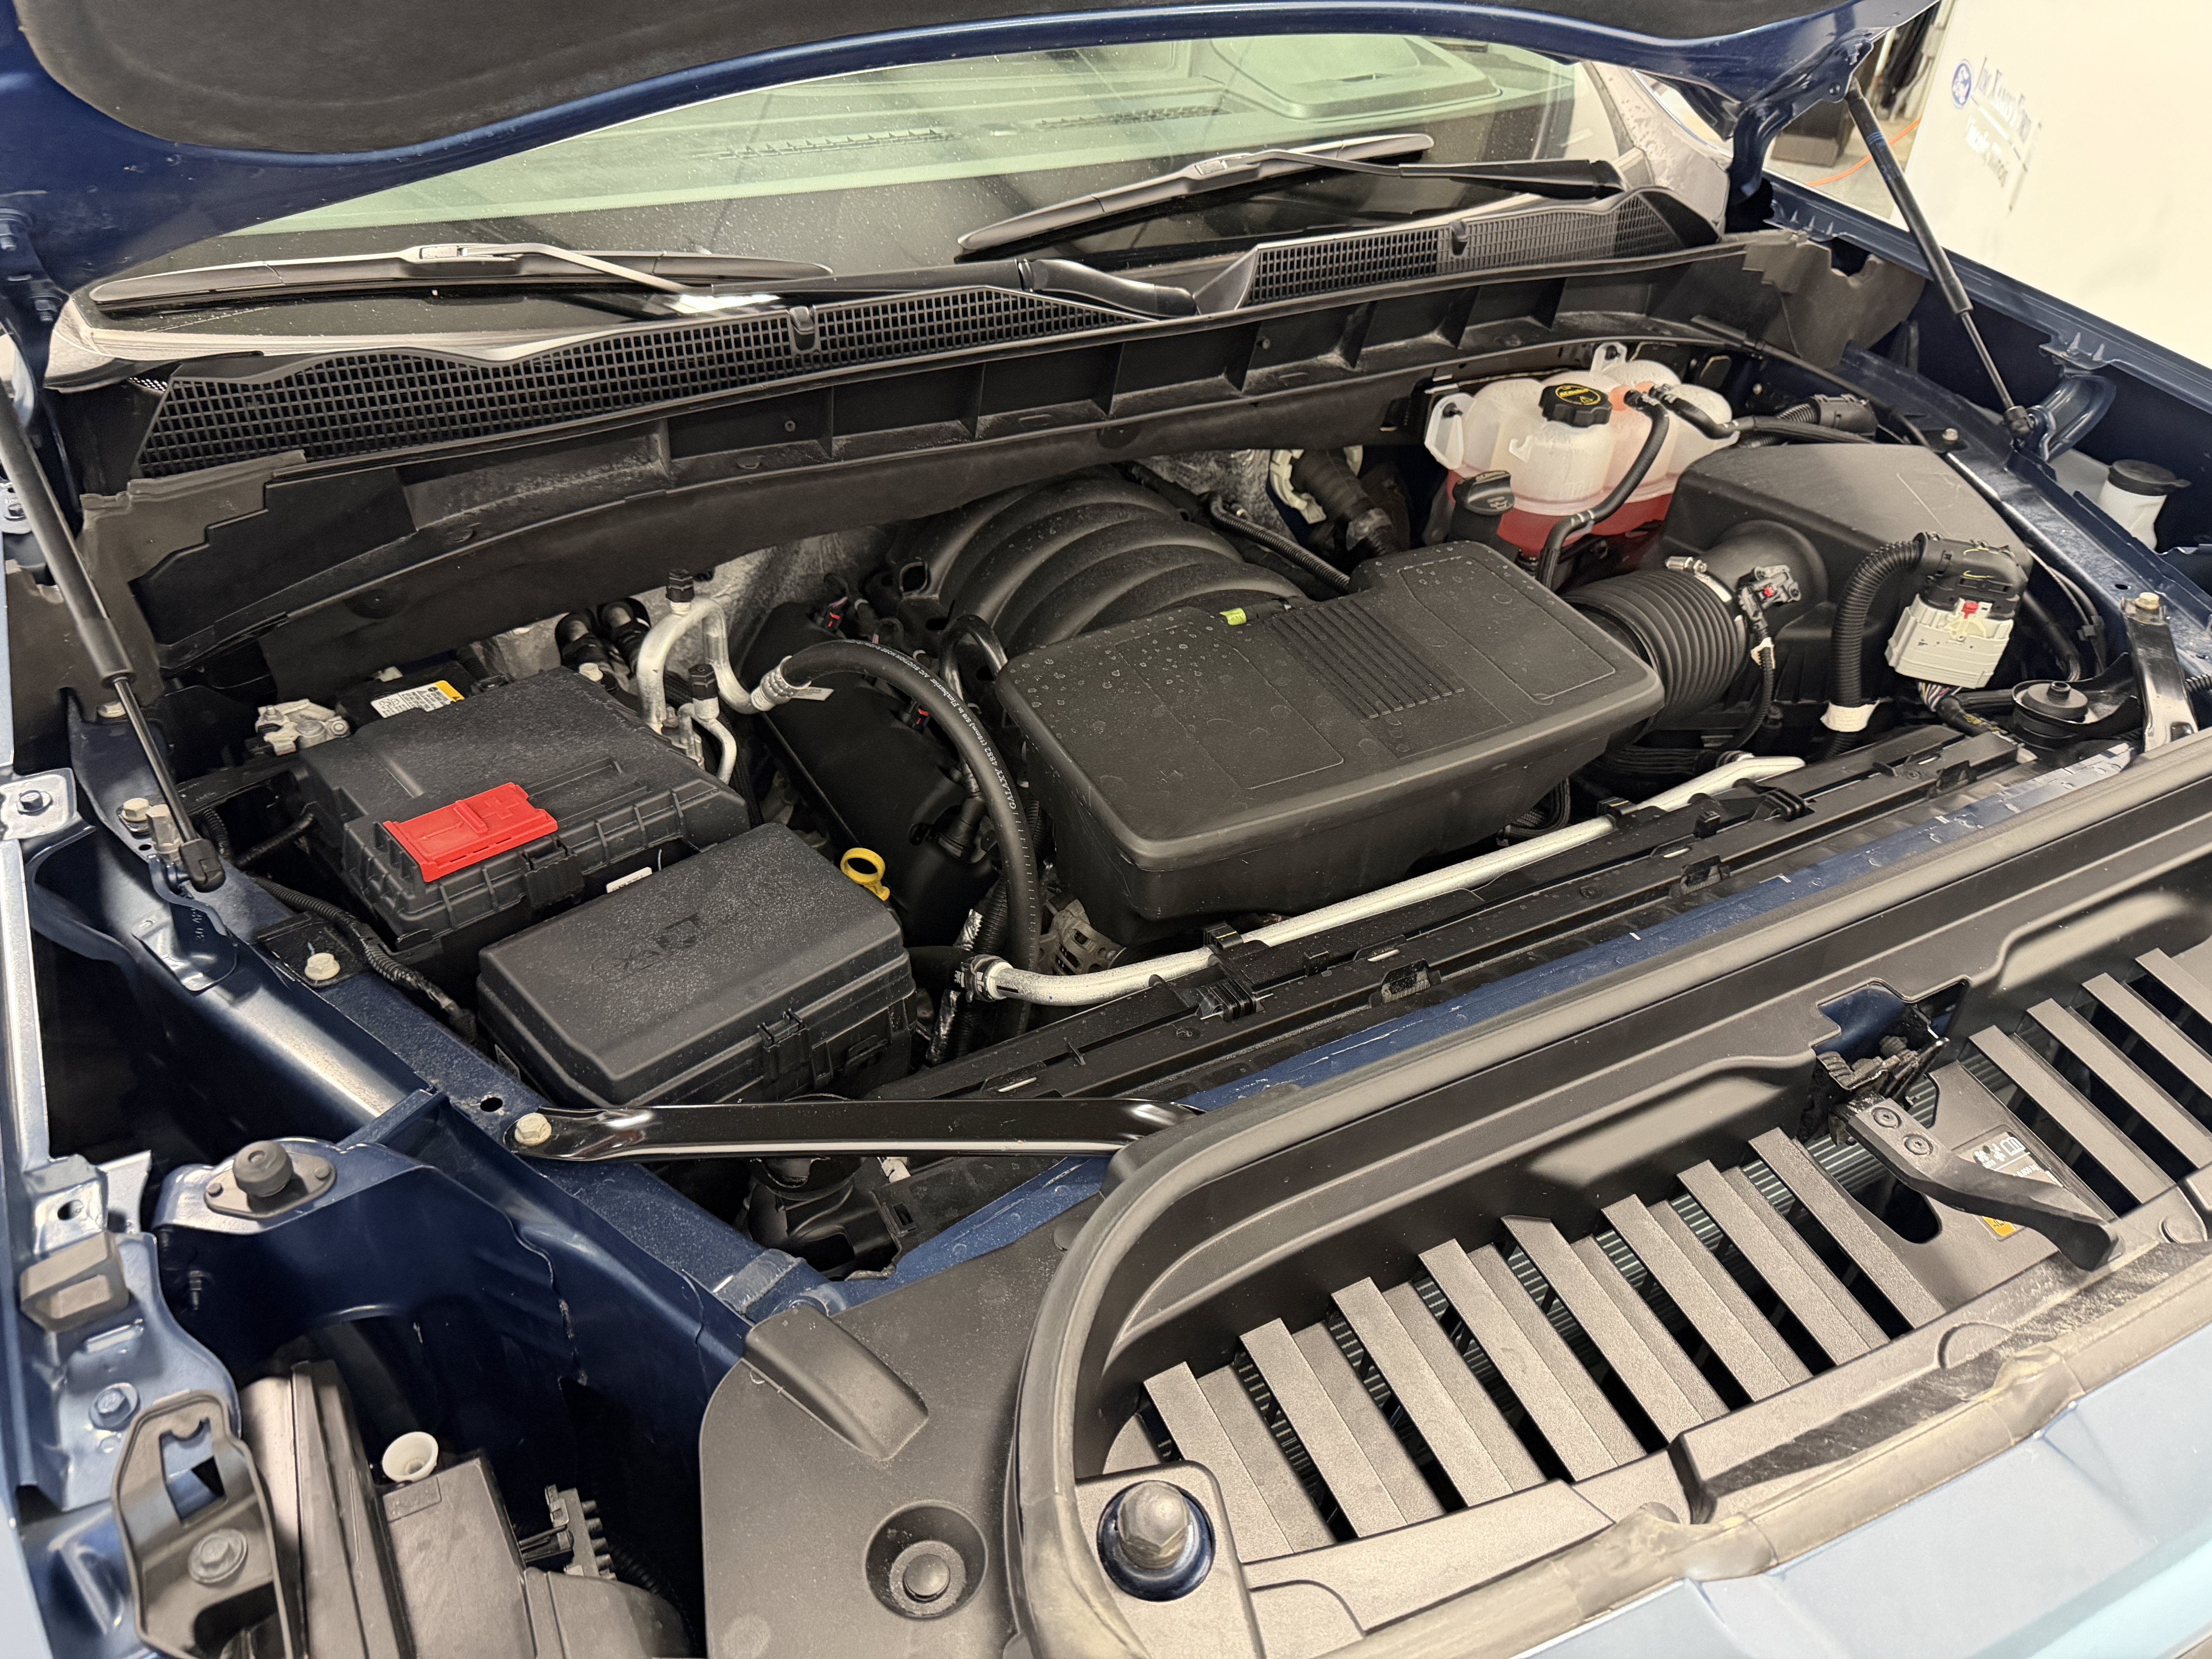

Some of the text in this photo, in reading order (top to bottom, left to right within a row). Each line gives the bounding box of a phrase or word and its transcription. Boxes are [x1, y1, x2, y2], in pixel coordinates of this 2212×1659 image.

[895, 654, 921, 671] SUCTION
[984, 747, 998, 766] 4882
[994, 768, 1017, 810] GALAXY
